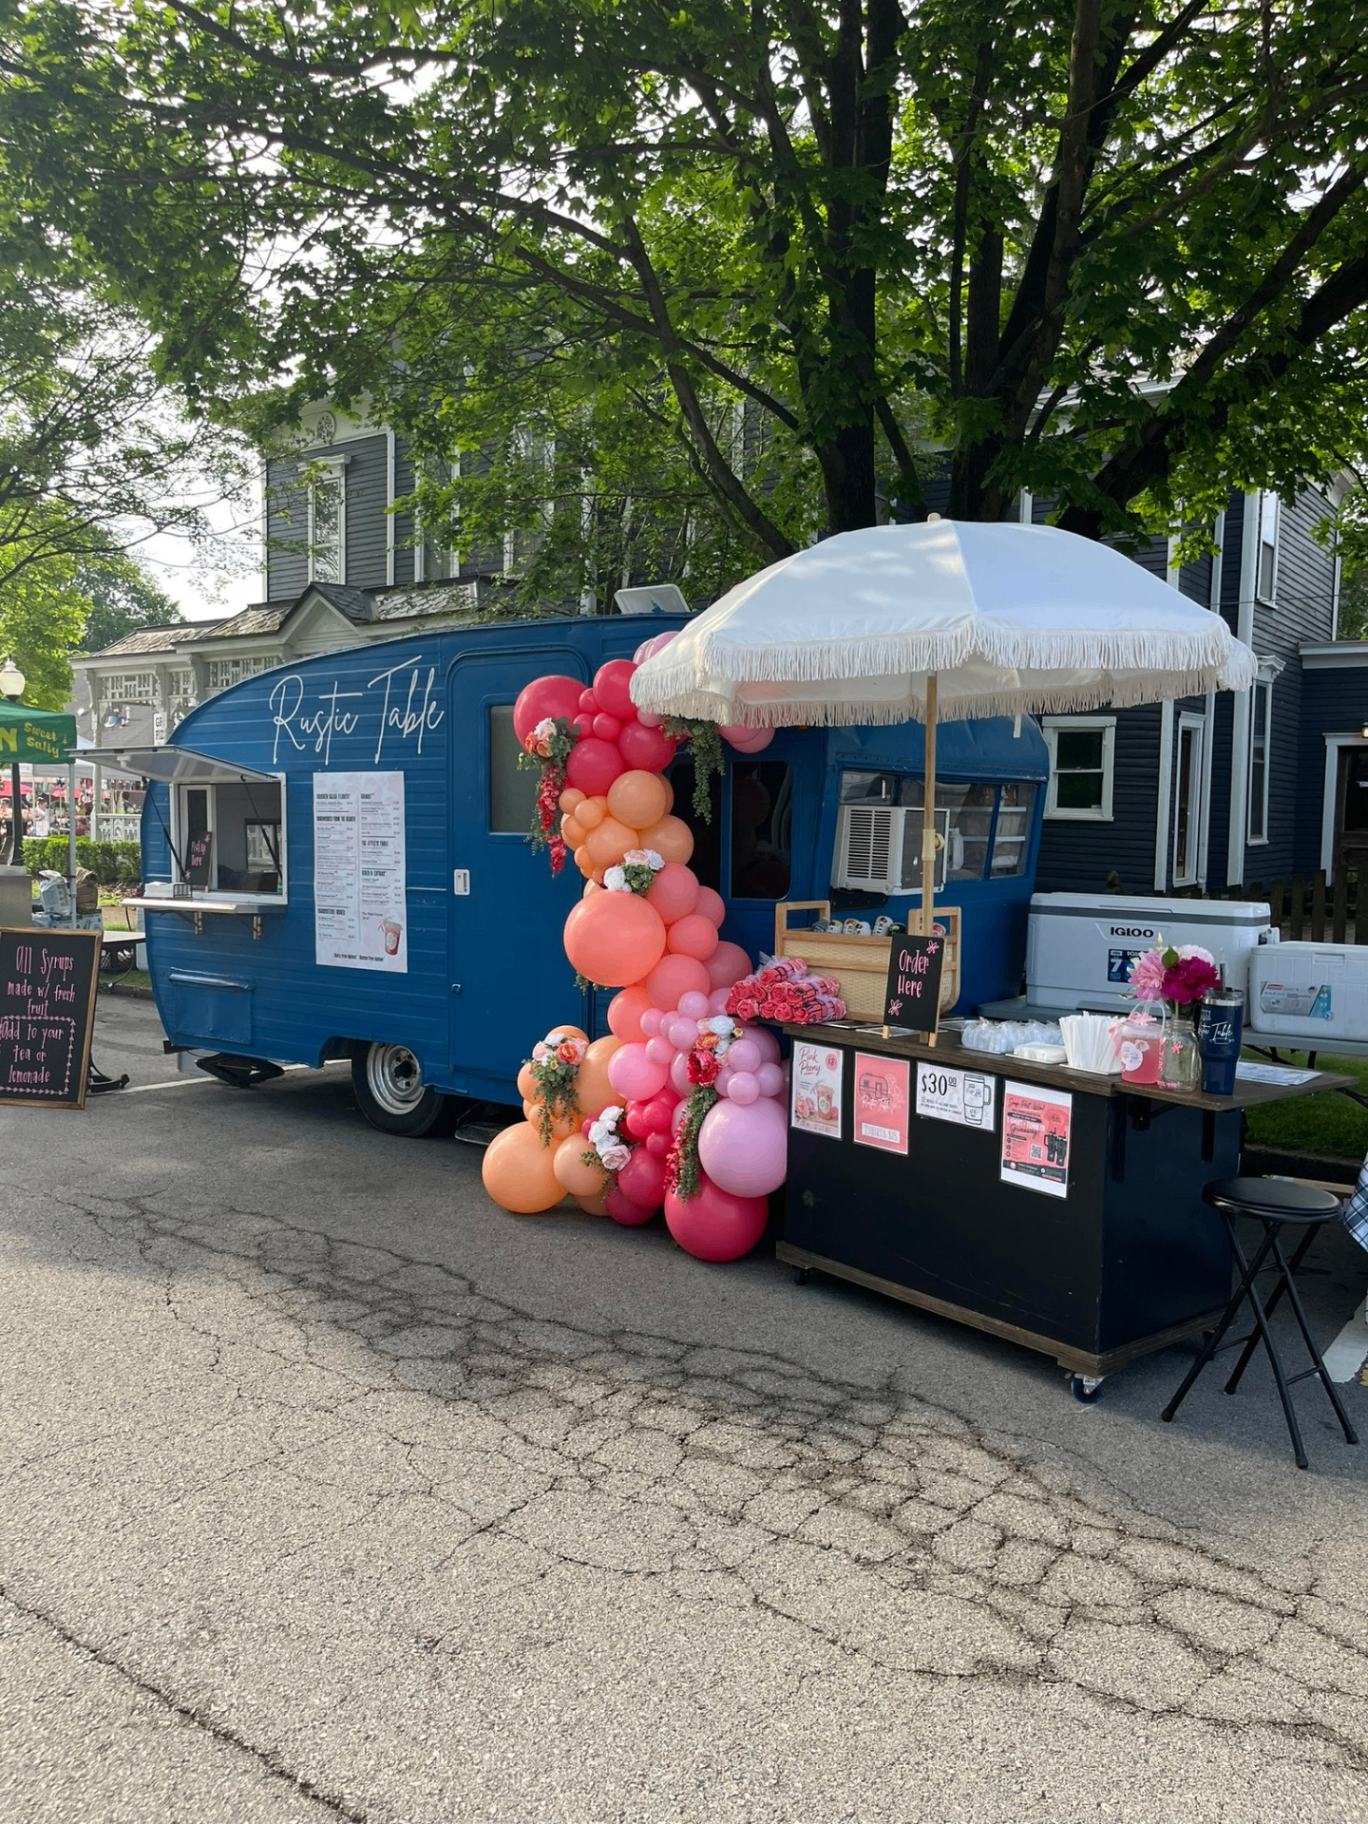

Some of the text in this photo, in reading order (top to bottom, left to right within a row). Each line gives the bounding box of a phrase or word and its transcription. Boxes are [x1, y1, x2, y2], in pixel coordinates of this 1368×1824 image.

[269, 655, 444, 766] Rustic Table
[24, 722, 57, 741] Sweet
[26, 737, 59, 758] Salty
[1110, 927, 1154, 938] IGLOO
[40, 947, 74, 982] Syrups
[898, 948, 929, 975] Order
[7, 980, 32, 997] made
[54, 984, 76, 1003] fresh
[897, 974, 922, 998] Here
[27, 998, 49, 1016] fruit
[28, 1024, 38, 1041] to
[42, 1028, 64, 1049] your
[13, 1045, 47, 1063] tea or
[9, 1065, 49, 1084] lemonade
[798, 1061, 822, 1076] Peony
